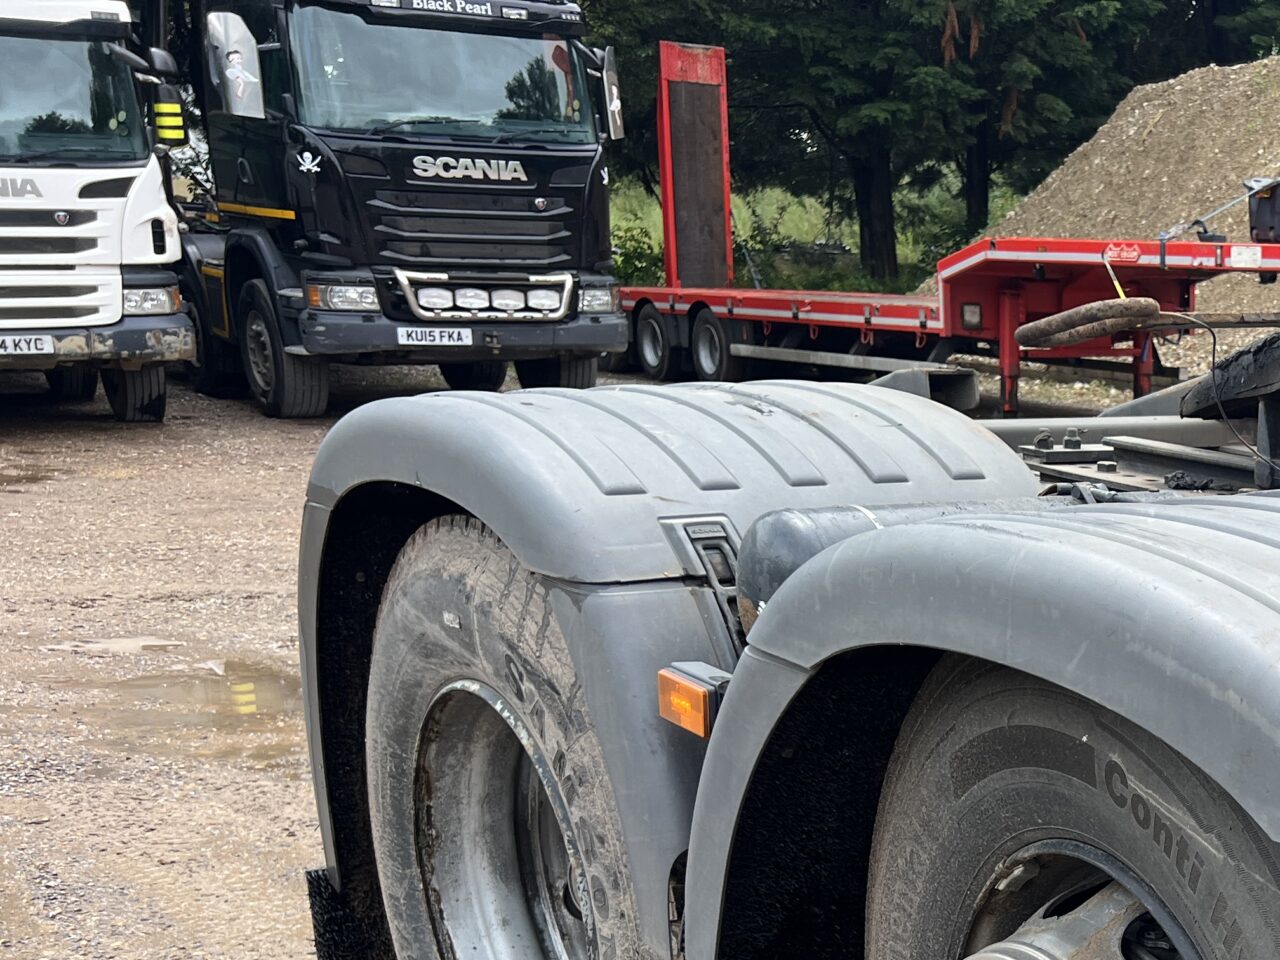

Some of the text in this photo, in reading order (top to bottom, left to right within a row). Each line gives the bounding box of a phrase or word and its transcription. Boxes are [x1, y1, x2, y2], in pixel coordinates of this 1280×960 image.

[412, 0, 492, 15] Black Pearl
[412, 155, 528, 182] SCANIA
[439, 330, 464, 342] FKA
[13, 337, 44, 352] KYC
[1103, 757, 1205, 895] Conti
